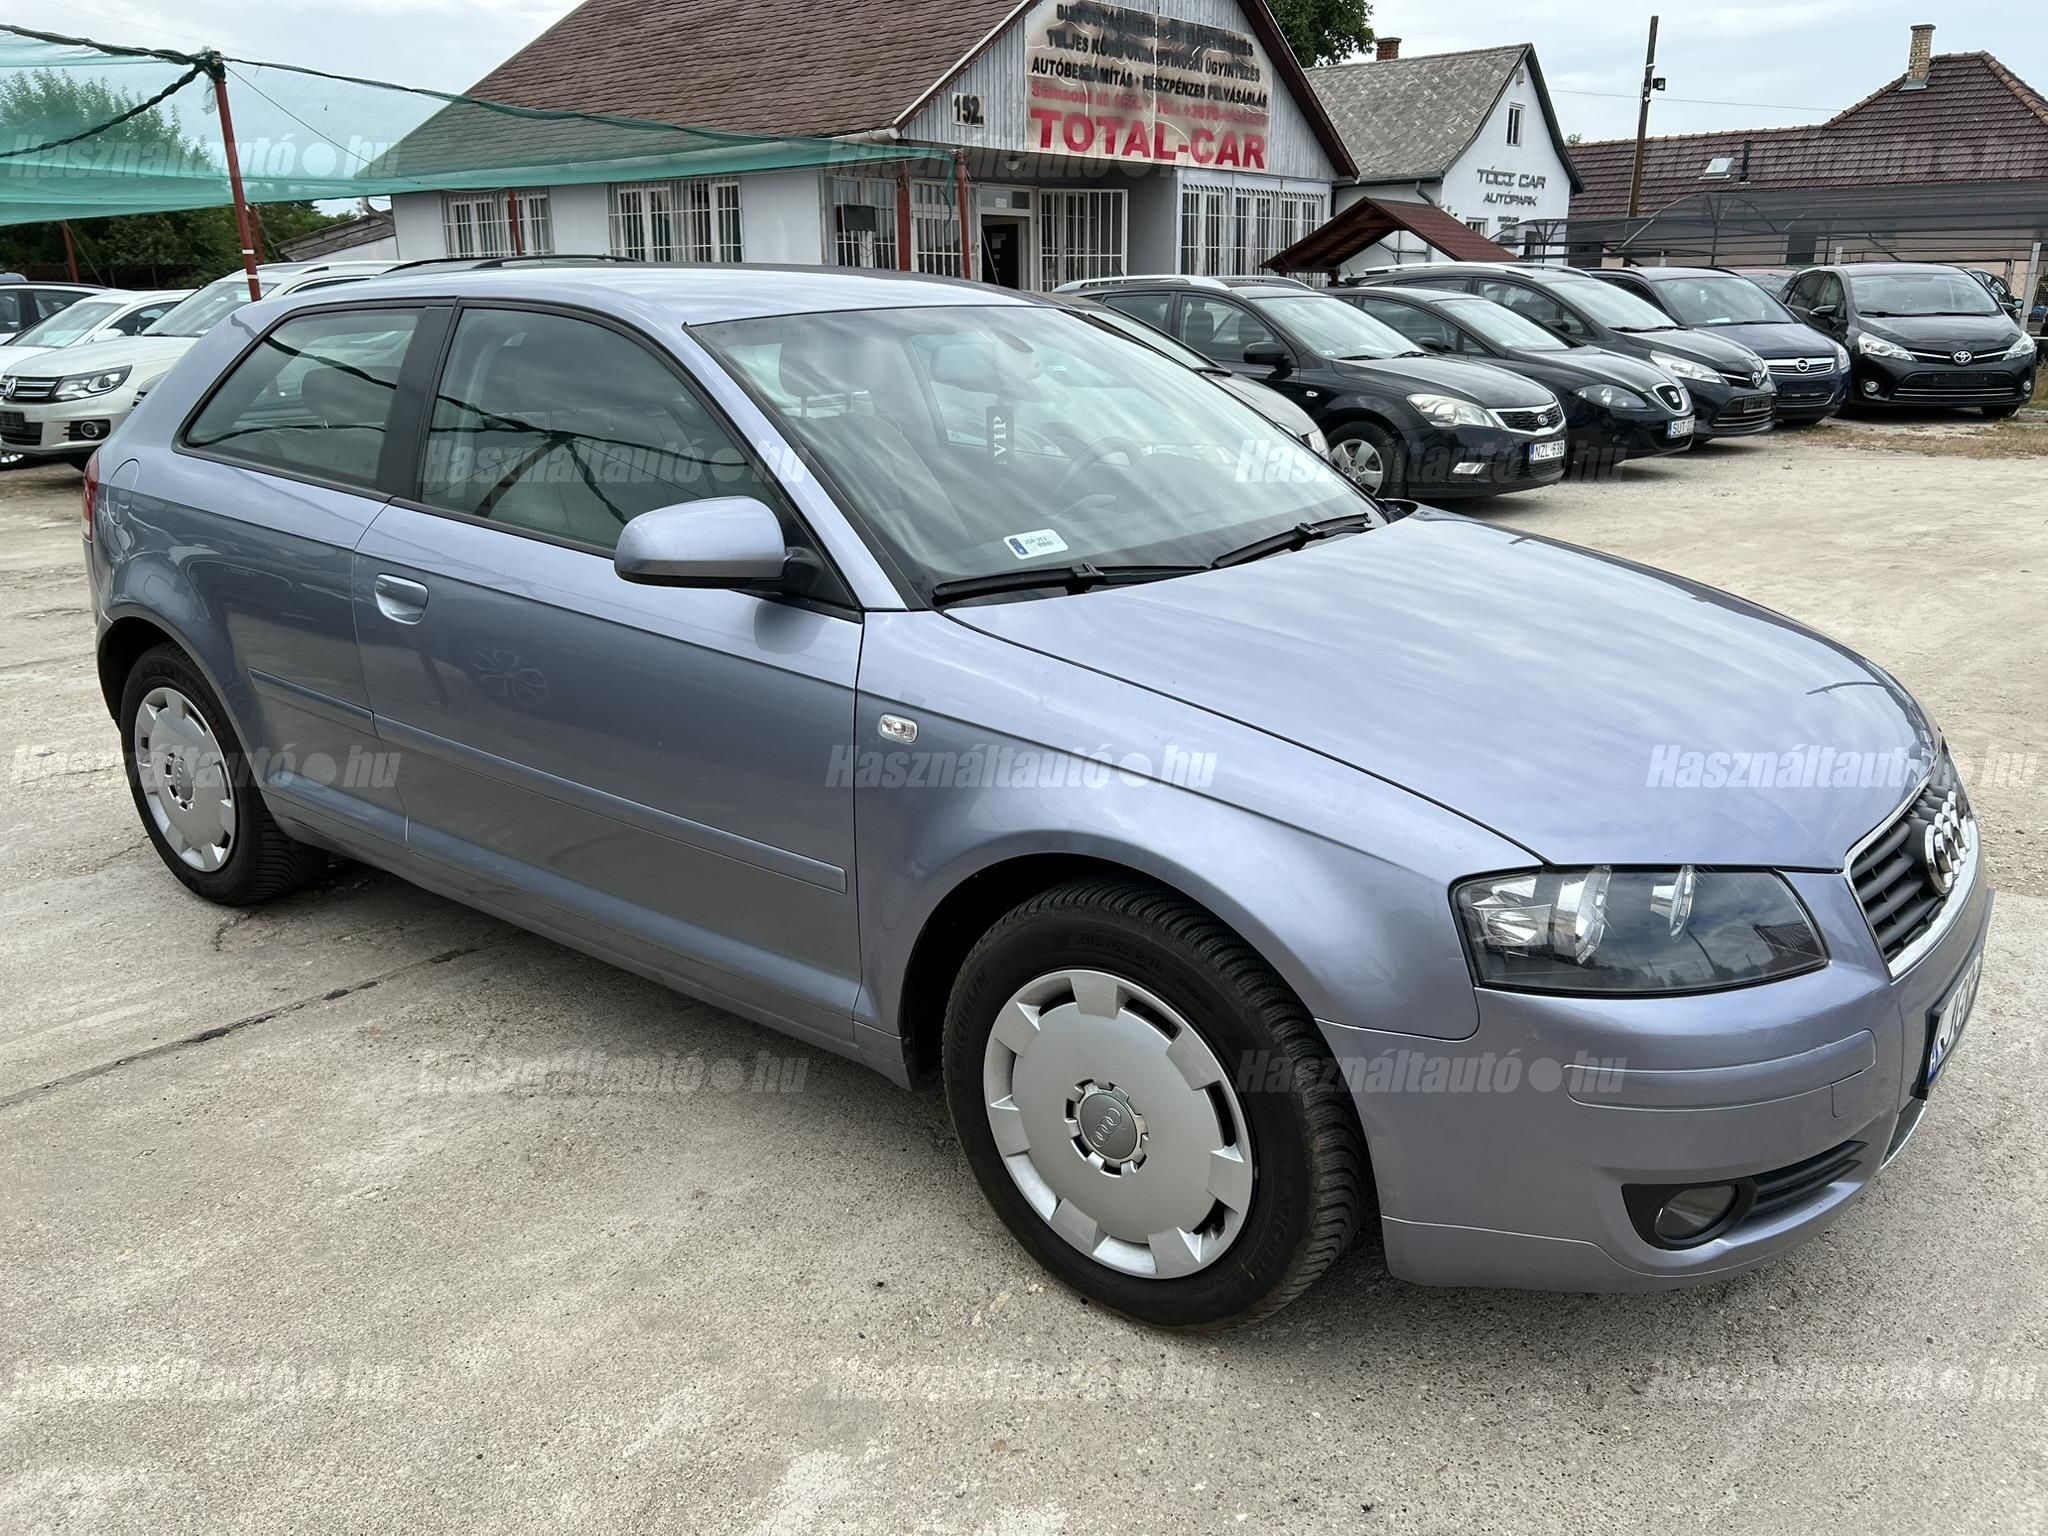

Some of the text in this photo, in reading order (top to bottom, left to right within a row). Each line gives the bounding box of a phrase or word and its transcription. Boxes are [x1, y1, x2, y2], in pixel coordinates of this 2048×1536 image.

[1031, 57, 1132, 87] AUTÓBEÁMÍTÁS
[1208, 85, 1267, 108] FVÁSÁRLÁS
[1030, 107, 1266, 170] TOTAL-CAR
[1483, 190, 1538, 207] AUTÓPARK
[1519, 173, 1546, 190] CAR
[993, 415, 1007, 458] VIP
